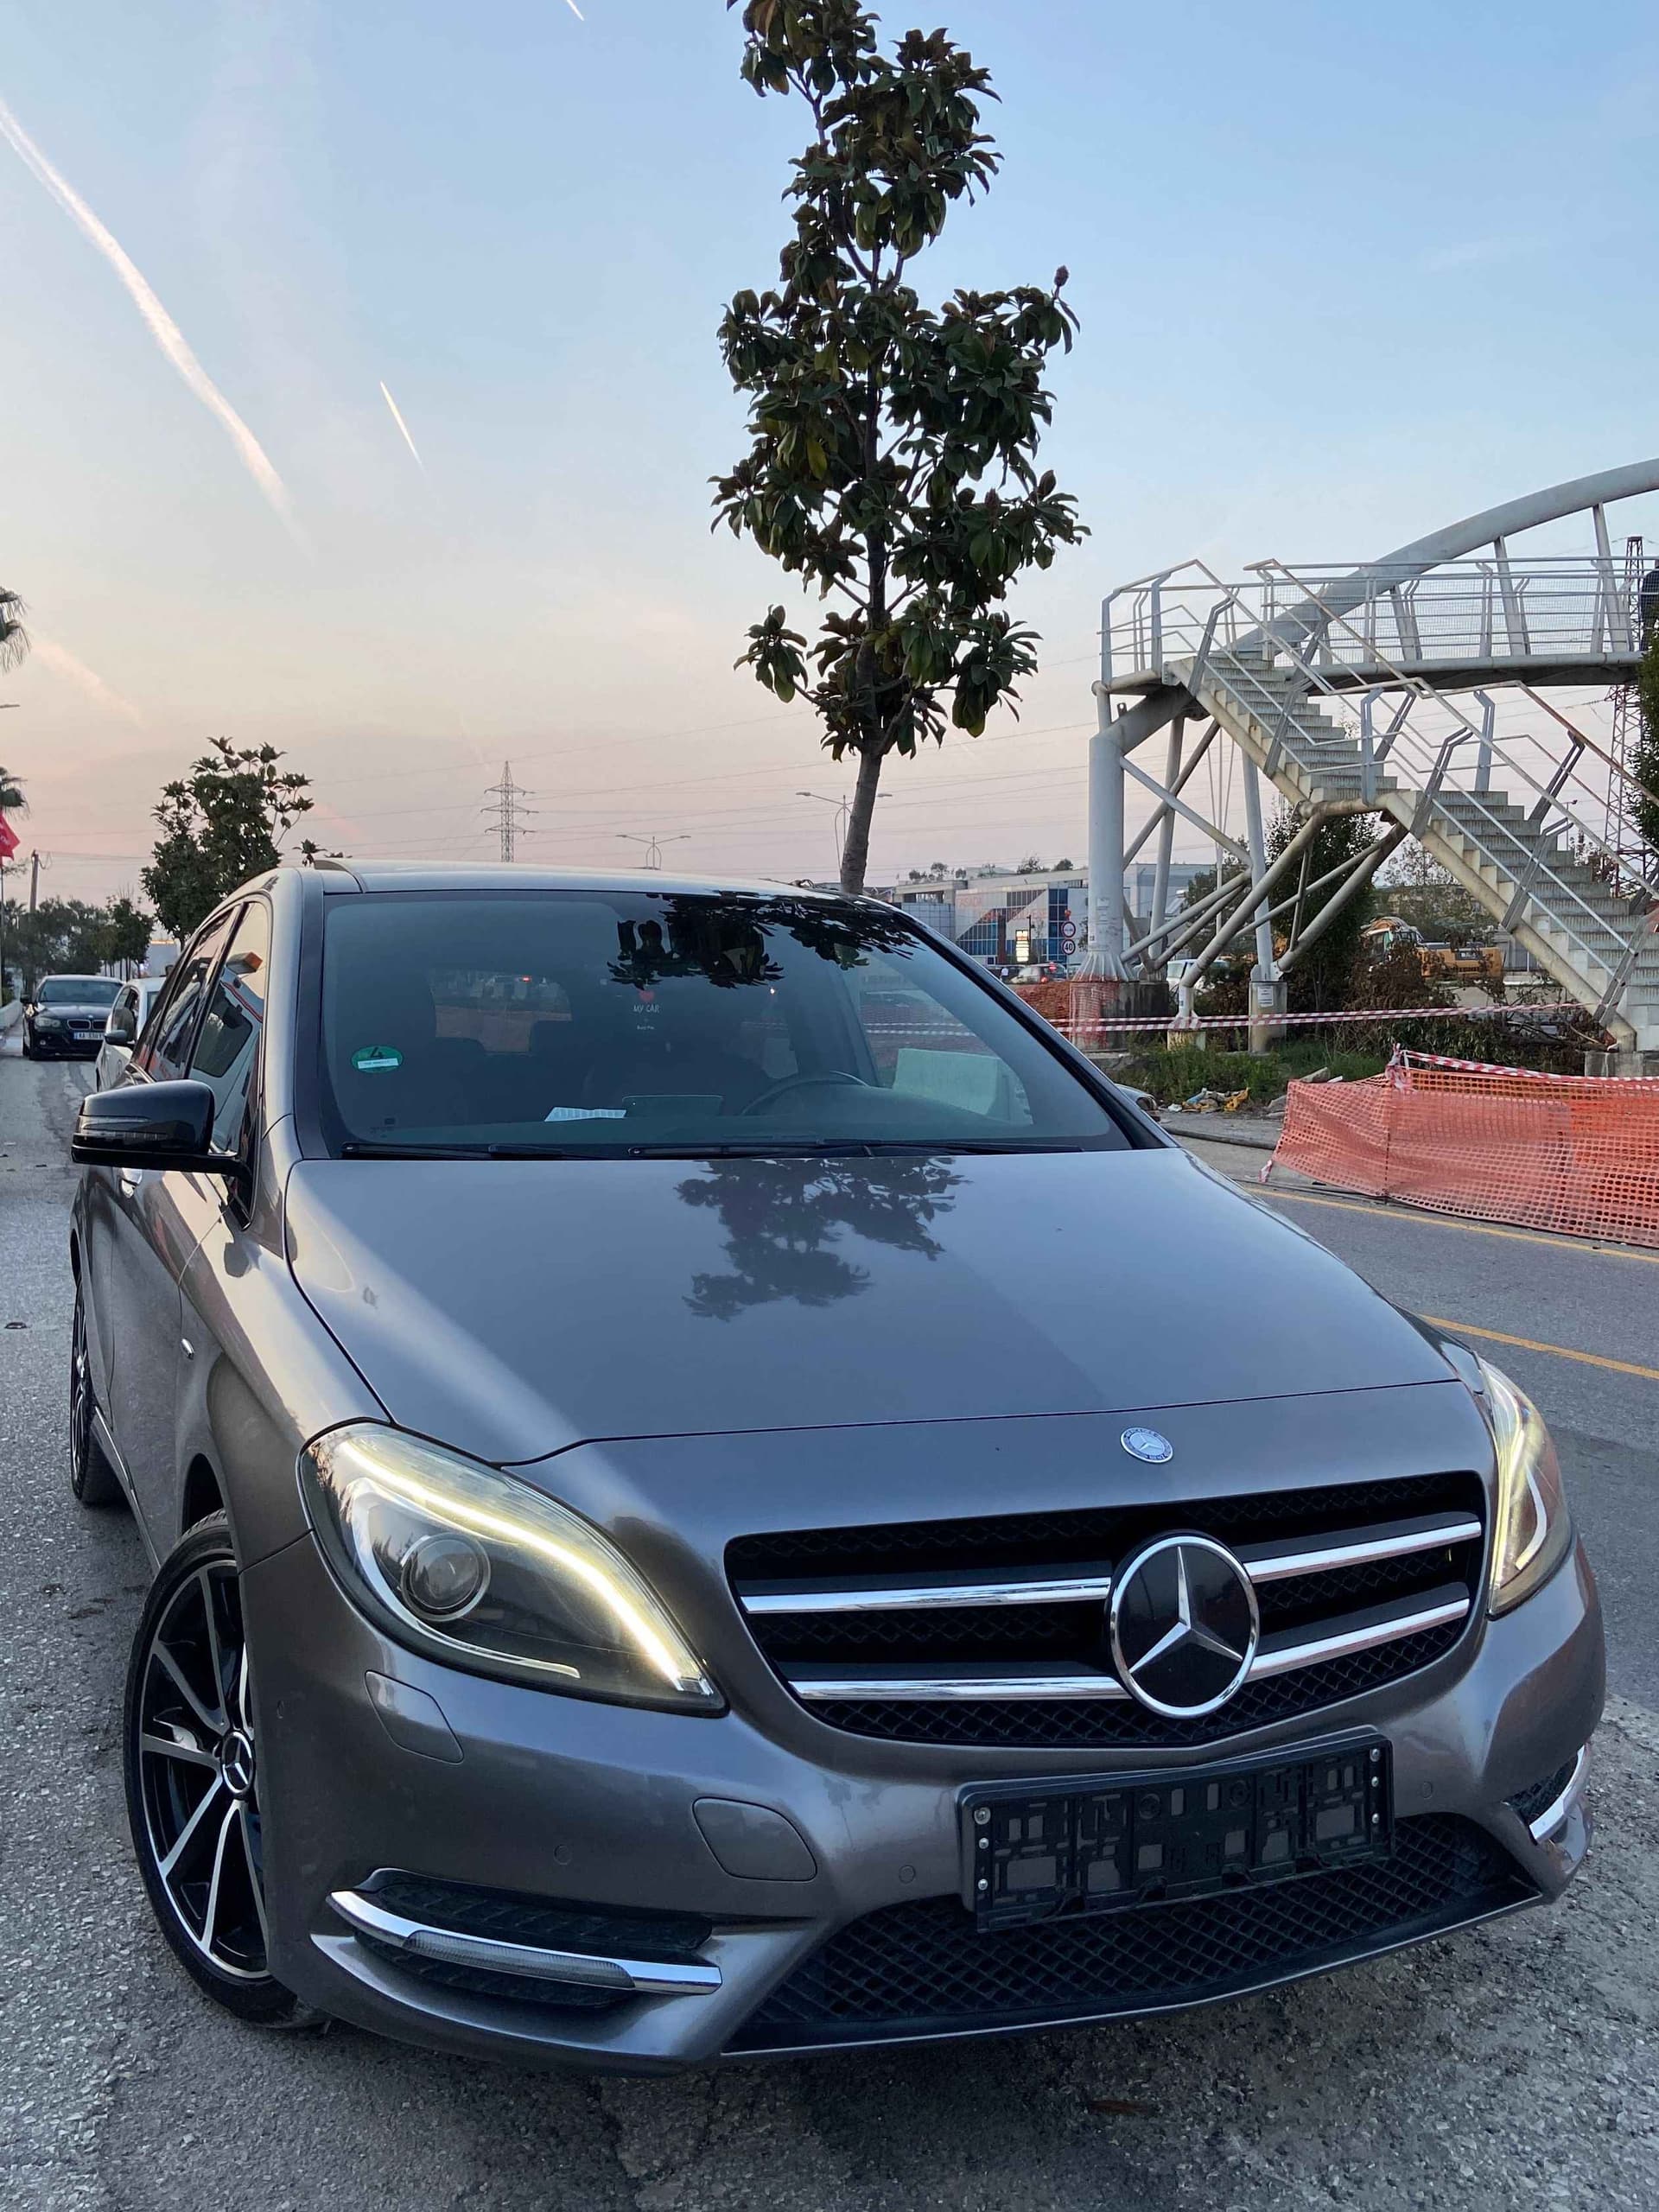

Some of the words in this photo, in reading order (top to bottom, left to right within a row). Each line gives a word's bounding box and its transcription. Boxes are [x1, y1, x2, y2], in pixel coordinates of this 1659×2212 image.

[1065, 942, 1073, 951] 40
[646, 1004, 660, 1014] CAR
[370, 1046, 384, 1059] 4
